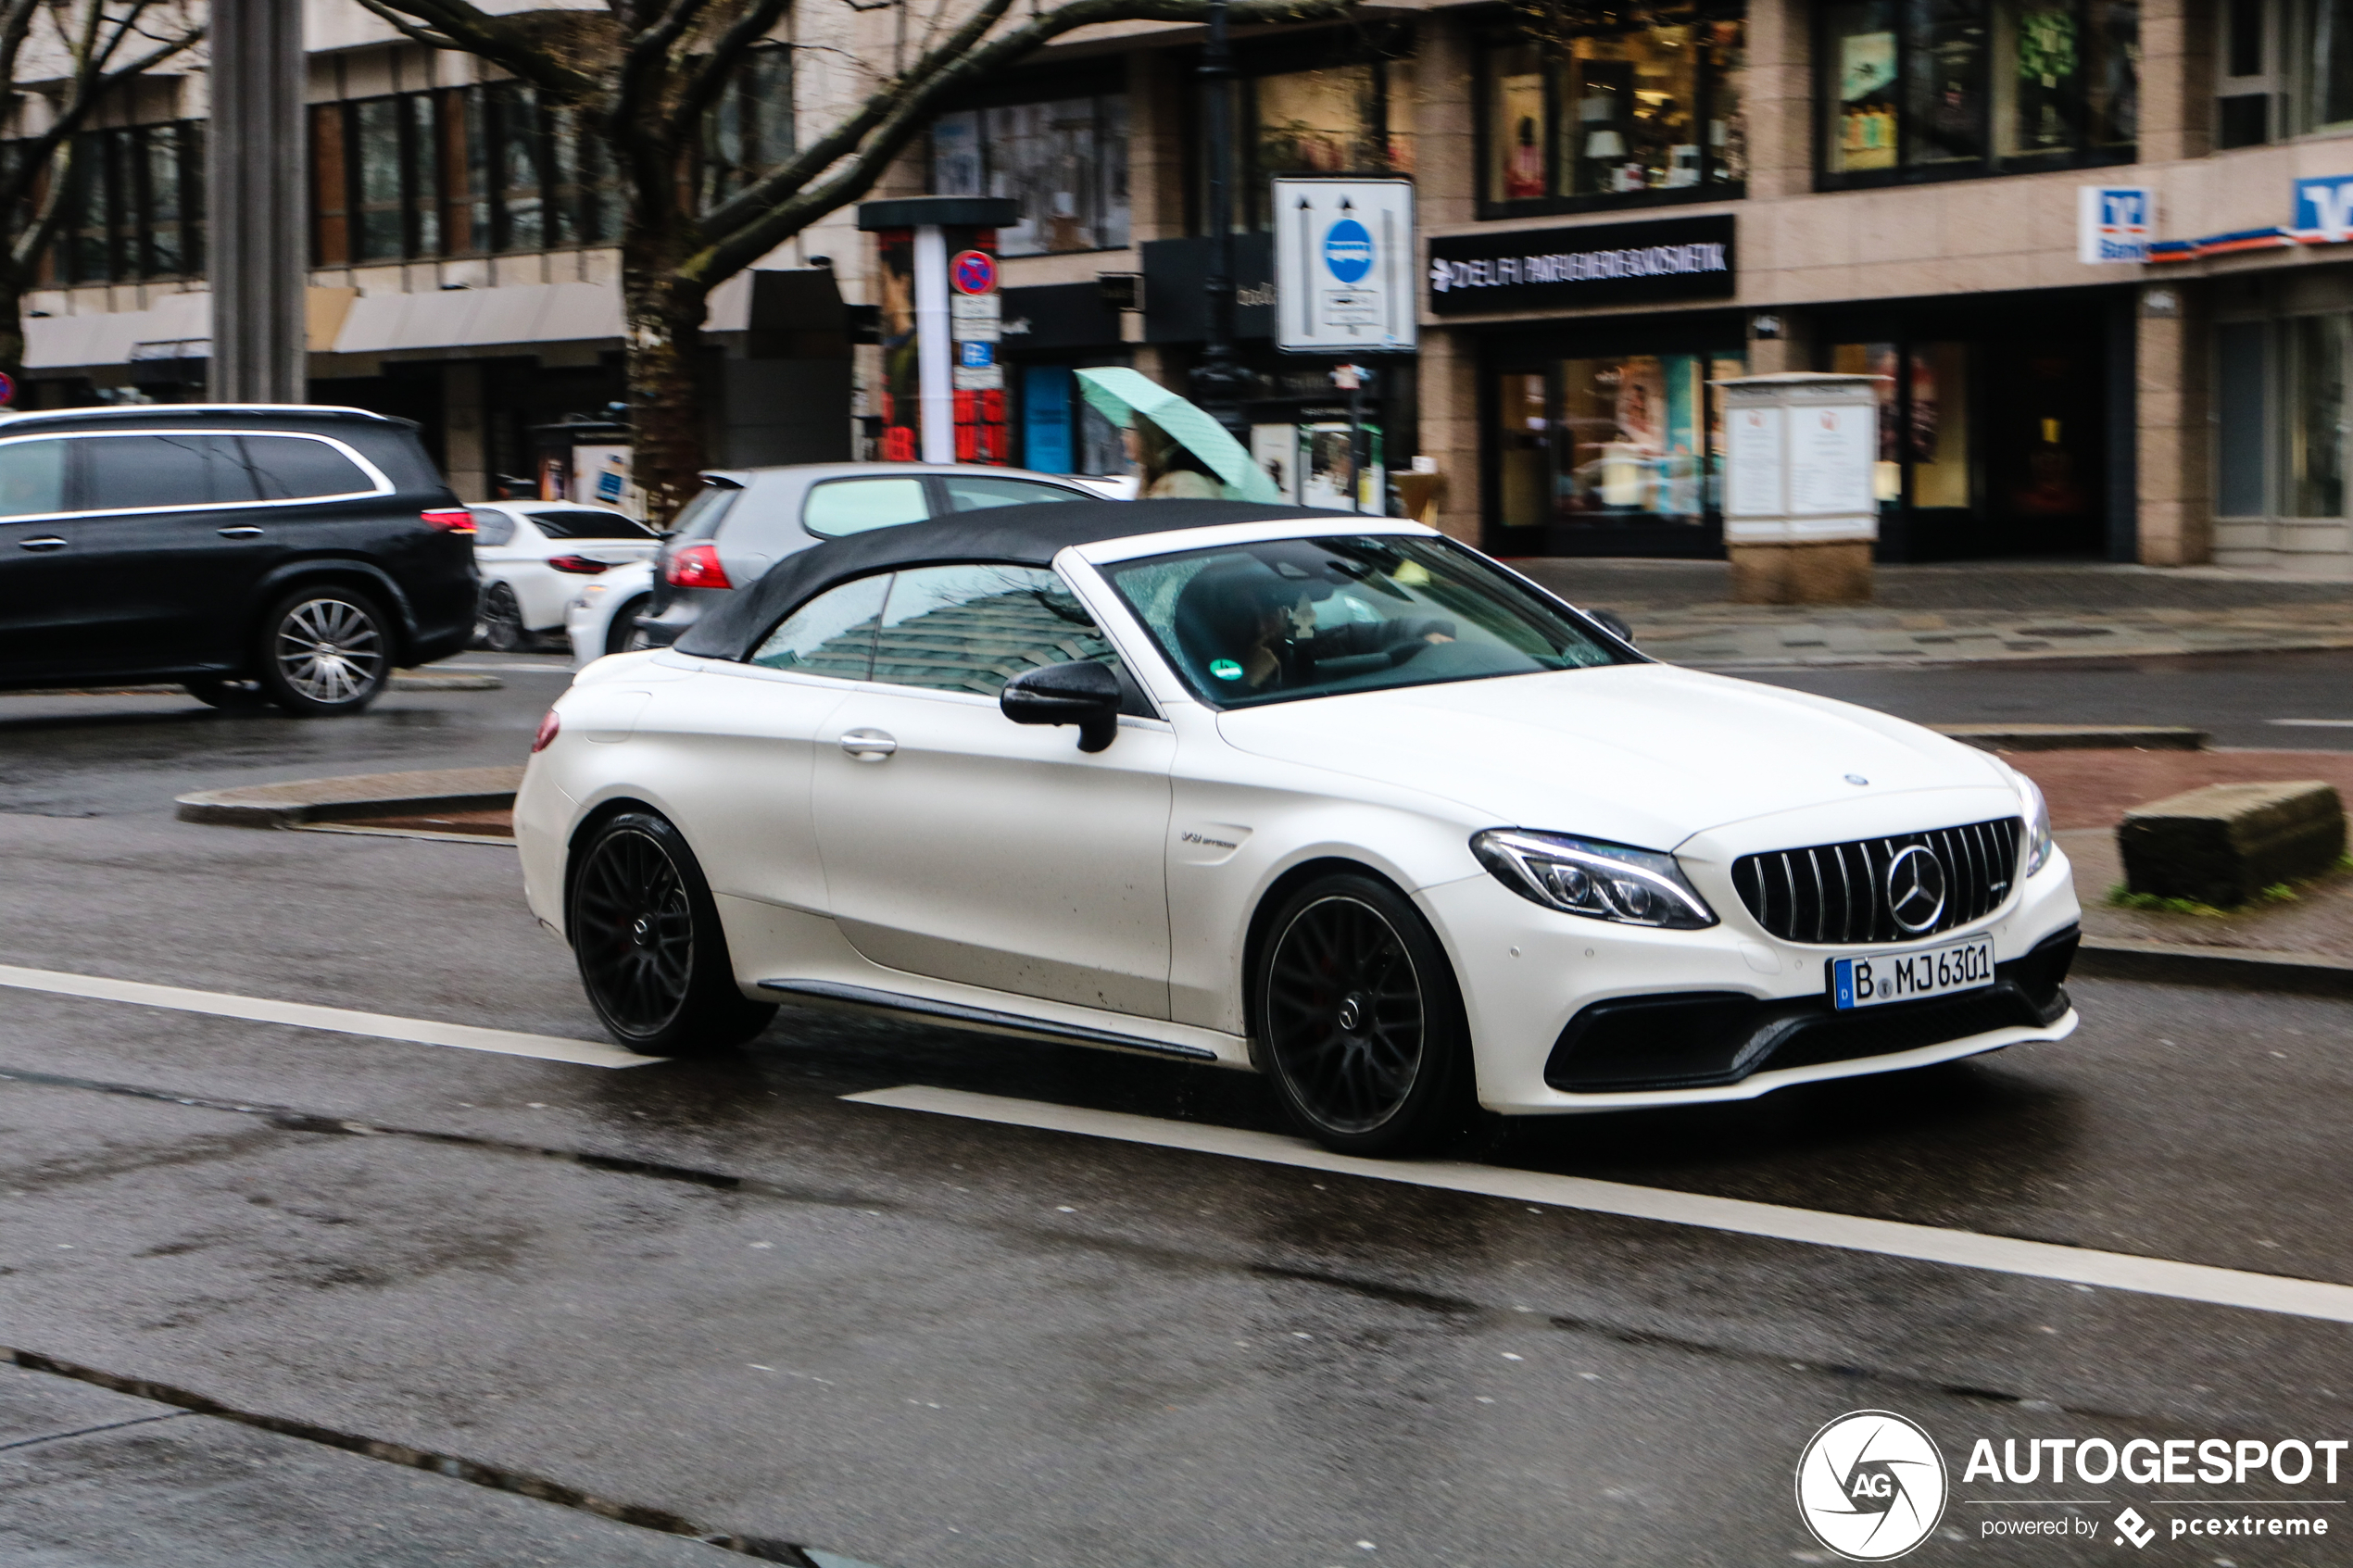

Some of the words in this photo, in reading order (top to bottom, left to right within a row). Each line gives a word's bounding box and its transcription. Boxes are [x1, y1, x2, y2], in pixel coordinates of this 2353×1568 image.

[1452, 257, 1524, 289] DELFI
[1842, 988, 1849, 1000] D
[1856, 963, 1874, 998] B
